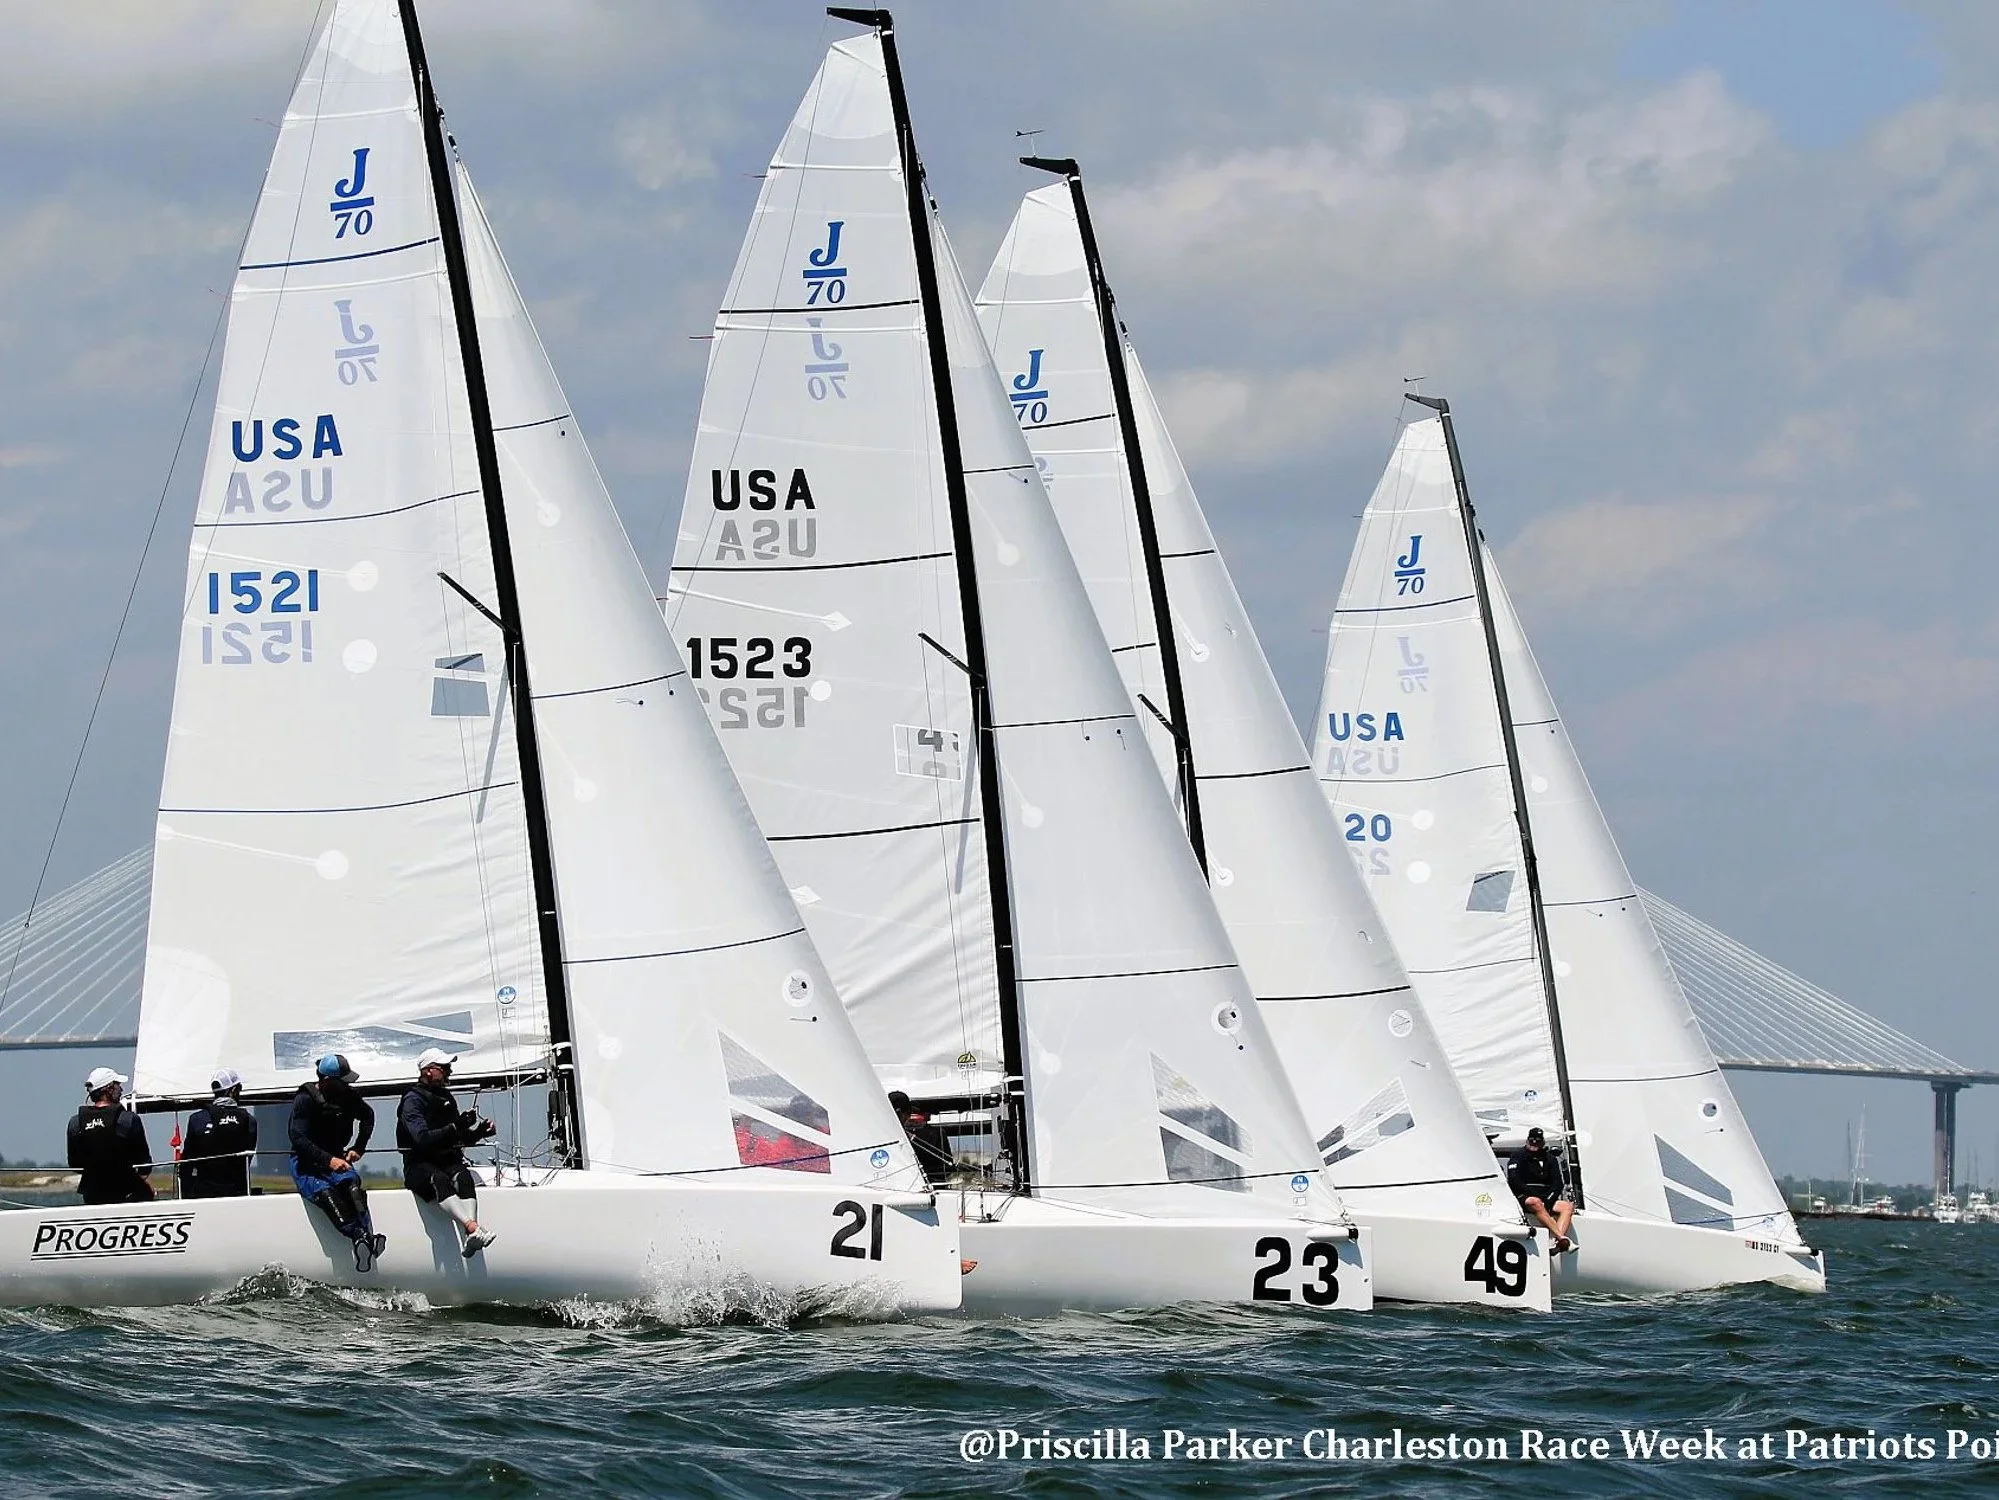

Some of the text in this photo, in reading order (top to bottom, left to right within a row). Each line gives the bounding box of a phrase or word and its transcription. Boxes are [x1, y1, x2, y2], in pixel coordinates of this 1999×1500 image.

[334, 147, 371, 198] J
[334, 209, 373, 239] 70
[809, 221, 845, 267] J
[805, 278, 846, 305] 70
[1013, 348, 1044, 391] J
[1013, 401, 1048, 424] 70
[232, 414, 343, 463] USA
[712, 468, 816, 511] USA
[1397, 534, 1423, 569] J
[208, 569, 319, 615] 1521
[1397, 576, 1424, 596] 70
[686, 636, 812, 679] 1523
[1328, 712, 1405, 742] USA
[1344, 813, 1392, 842] 20
[831, 1200, 884, 1262] 21
[1253, 1236, 1340, 1307] 23
[1464, 1236, 1529, 1298] 49
